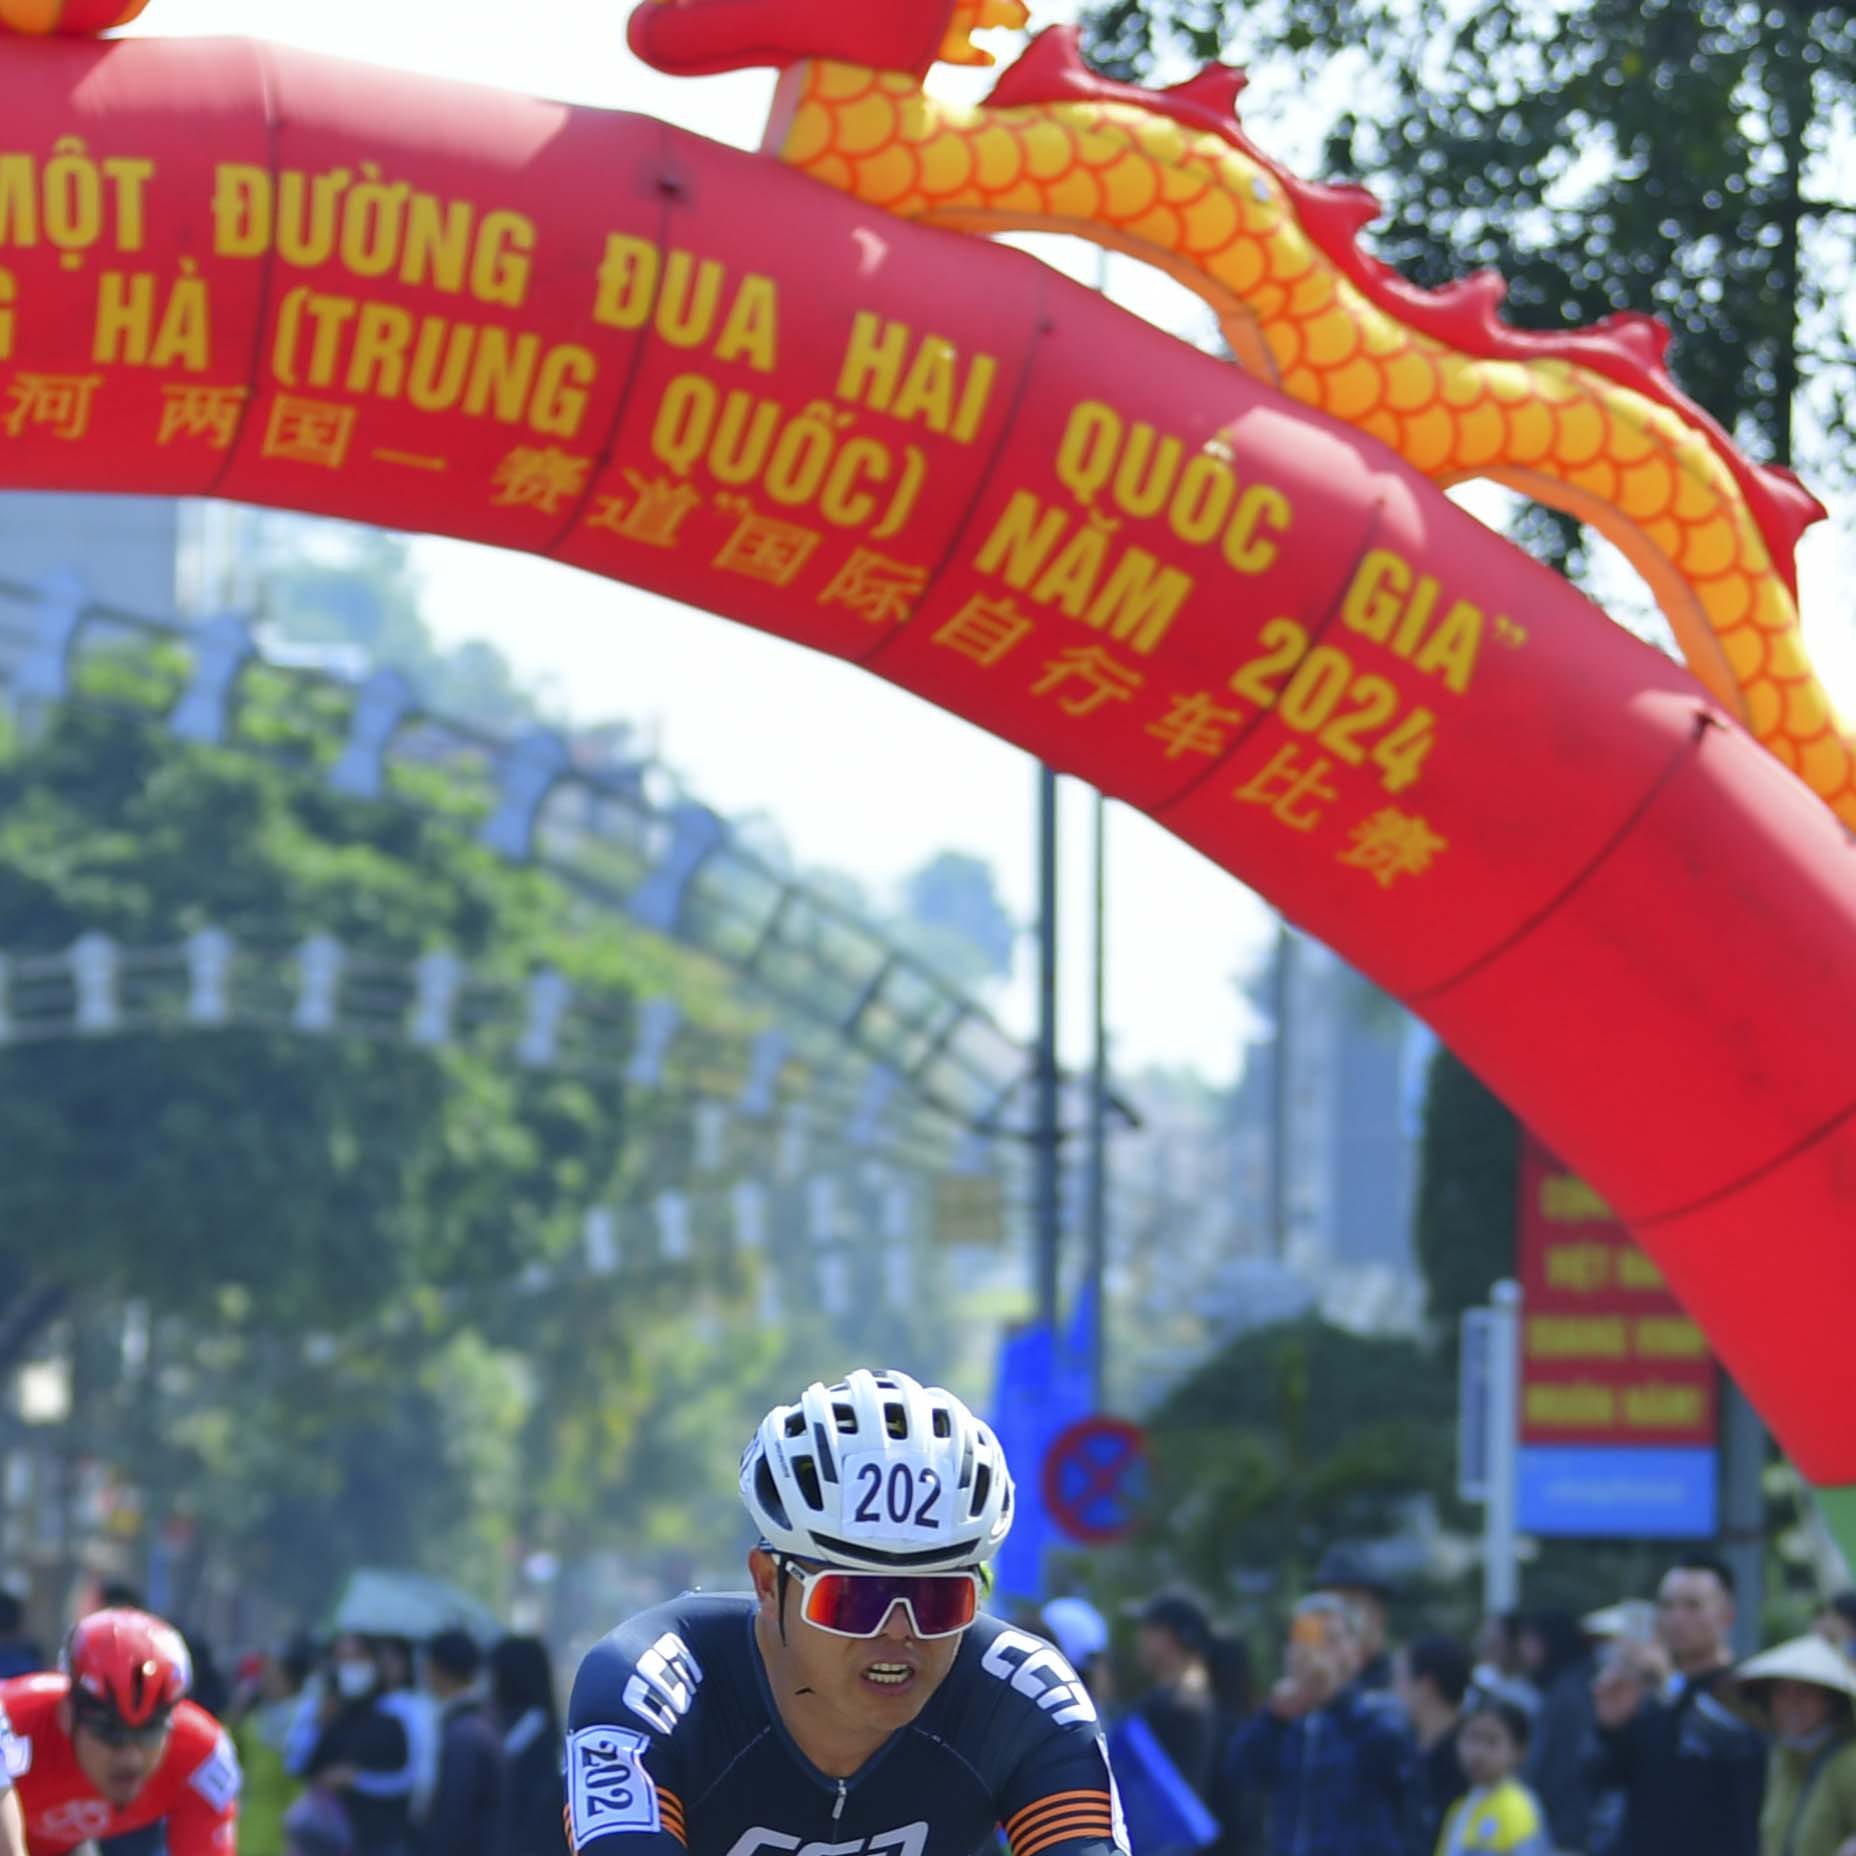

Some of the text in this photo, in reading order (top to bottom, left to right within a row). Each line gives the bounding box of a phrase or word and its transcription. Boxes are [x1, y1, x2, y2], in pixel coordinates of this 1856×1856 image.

[210, 160, 536, 309] ĐƯỜNG
[593, 229, 778, 374] ĐUA
[835, 308, 998, 446] HAI
[1054, 399, 1292, 575] QUỐC
[91, 255, 211, 371] HÀ
[271, 285, 599, 440] (TRUNG
[649, 373, 926, 541] QUỐC)
[972, 488, 1195, 657] NĂM
[1227, 617, 1437, 795] 2024
[854, 1462, 942, 1529] 202
[580, 1738, 634, 1819] 202
